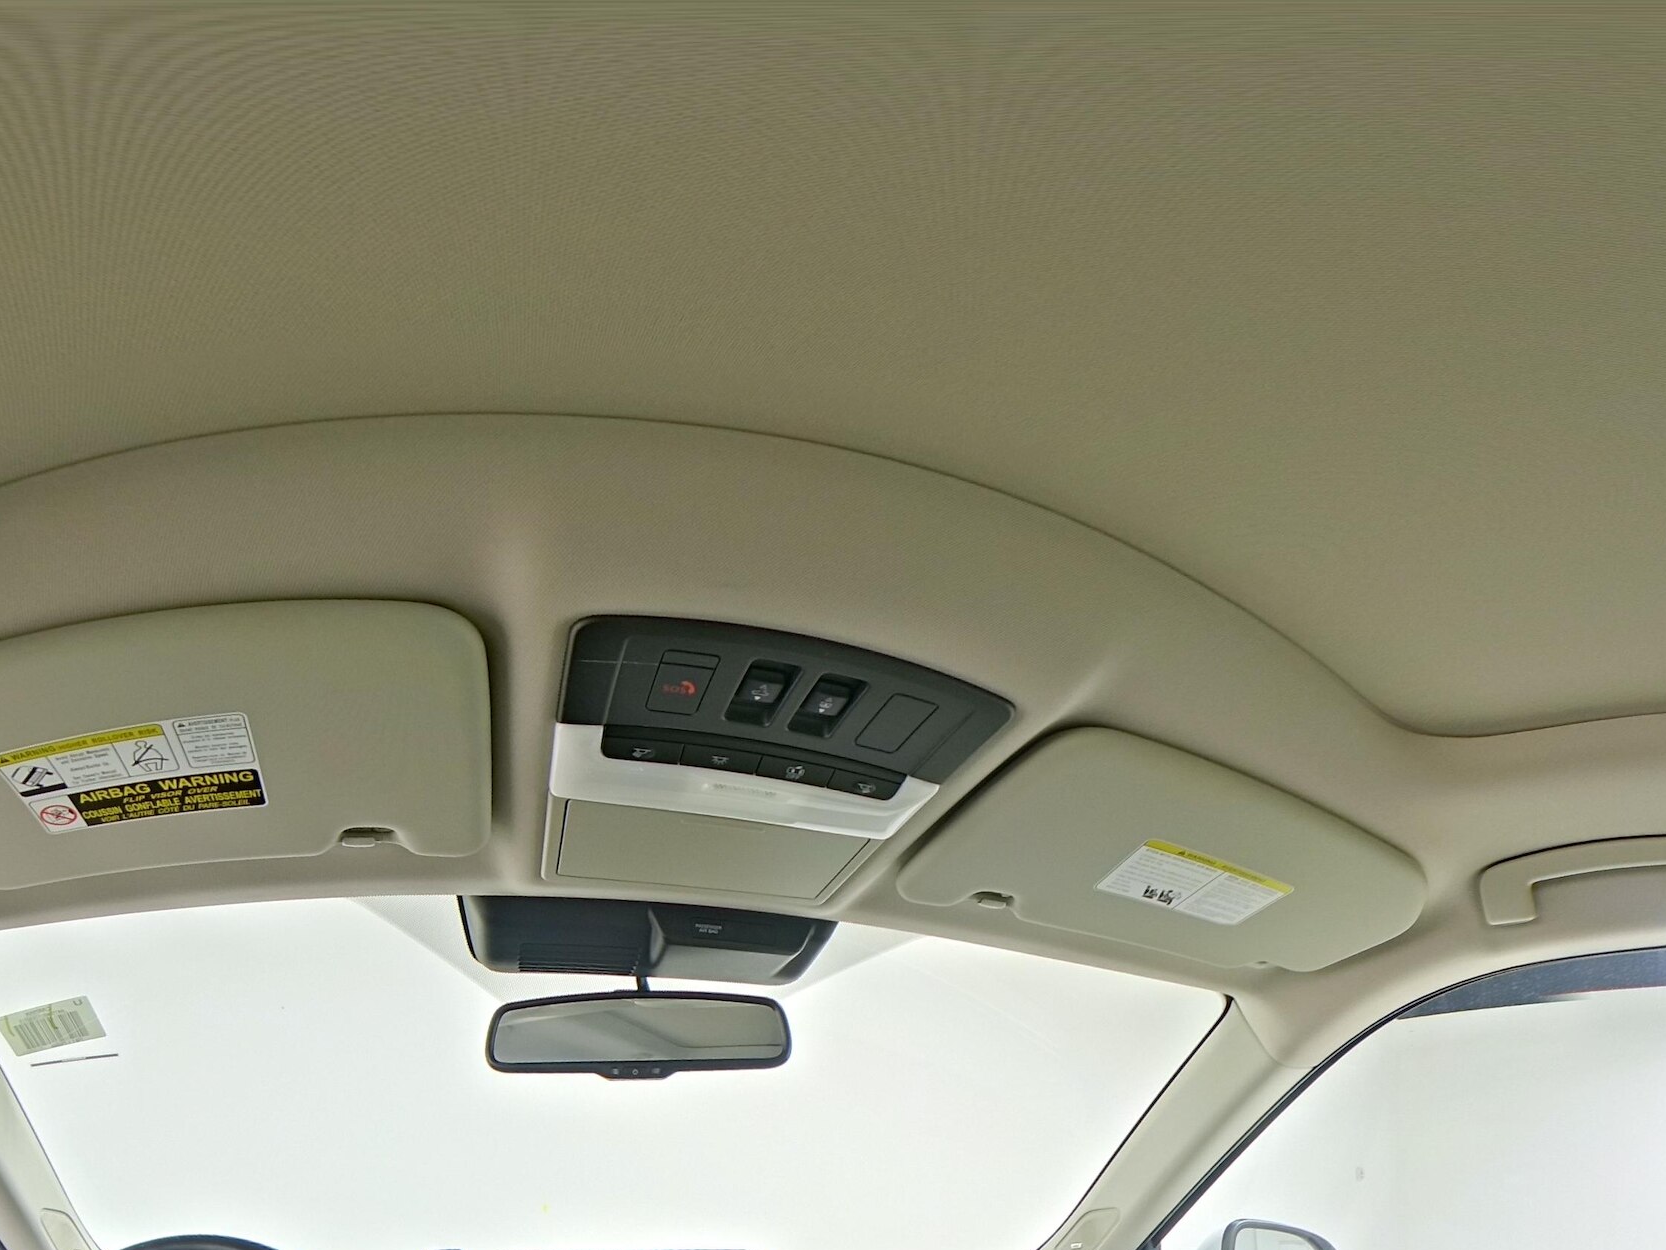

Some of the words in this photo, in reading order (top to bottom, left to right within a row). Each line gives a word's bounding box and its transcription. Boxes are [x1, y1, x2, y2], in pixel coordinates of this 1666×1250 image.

[11, 745, 56, 760] WARNING
[91, 731, 133, 743] ROLLOVER
[137, 728, 158, 736] RISK
[80, 783, 151, 804] AIRBAG
[157, 771, 254, 790] WARNING
[123, 794, 145, 804] FLIP
[150, 789, 182, 799] VISOR
[187, 785, 218, 795] OVER
[82, 805, 123, 820] COUSSIN
[125, 797, 181, 813] GONFLABLE
[184, 788, 262, 805] AVERTISSEMENT
[101, 814, 121, 823] VOIR
[183, 804, 195, 812] DU
[198, 799, 250, 810] PARE-SOLEIL
